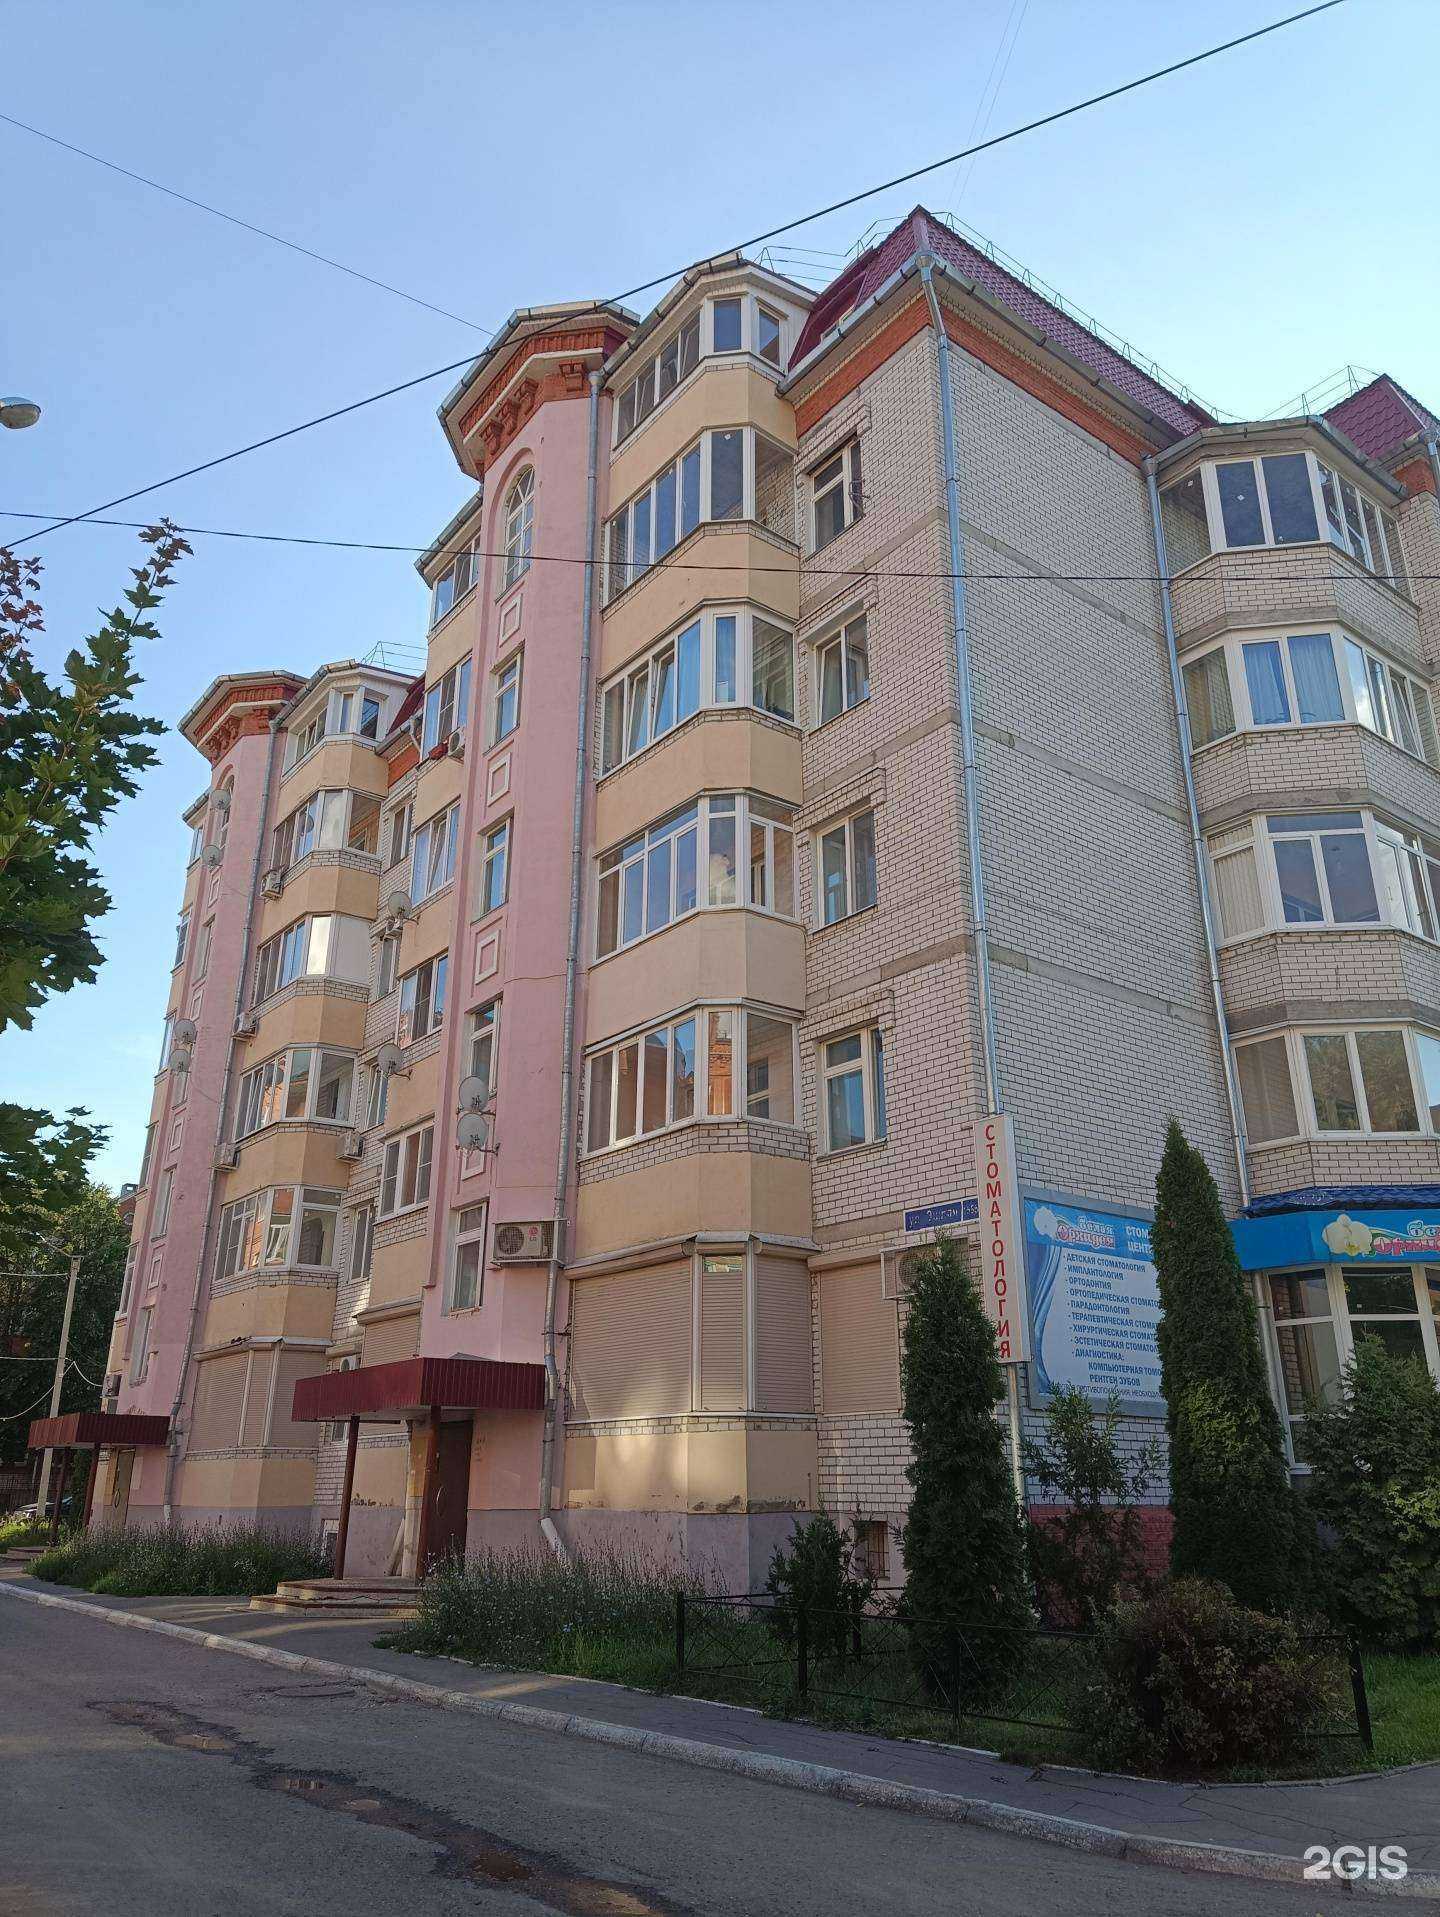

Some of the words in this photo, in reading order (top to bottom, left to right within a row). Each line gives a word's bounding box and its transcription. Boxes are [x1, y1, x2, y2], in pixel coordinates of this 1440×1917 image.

[1125, 1225, 1152, 1240] СТОМ
[985, 1124, 1010, 1359] СТОМАТОЛОГИЯ
[1066, 1253, 1096, 1266] ДЕТСКАЯ
[1097, 1258, 1146, 1273] СТОМАТОЛОГИЯ
[1067, 1264, 1124, 1281] ИМПЛАНТОЛОГИЯ
[1068, 1276, 1112, 1290] ОРТОДОНТИЯ
[1069, 1288, 1130, 1305] ОРТОПЕДИЧЕСКАЯ
[1130, 1296, 1160, 1308] СТОМАТО
[1071, 1300, 1130, 1315] ПАРАДОНТОЛОГИЯ
[1071, 1311, 1133, 1327] ТЕРАПЕВТИЧЕСКАЯ
[1072, 1324, 1129, 1339] ХИРУРГИЧЕСКАЯ
[1074, 1336, 1124, 1349] ЭСТЕТИЧЕСКАЯ
[1075, 1348, 1125, 1361] ДИАГНОСТИКА:
[1088, 1361, 1143, 1375] КОМПЬЮТЕРНАЯ
[1089, 1374, 1118, 1385] РЕНТГЕН
[1119, 1377, 1141, 1387] ЗУБОВ
